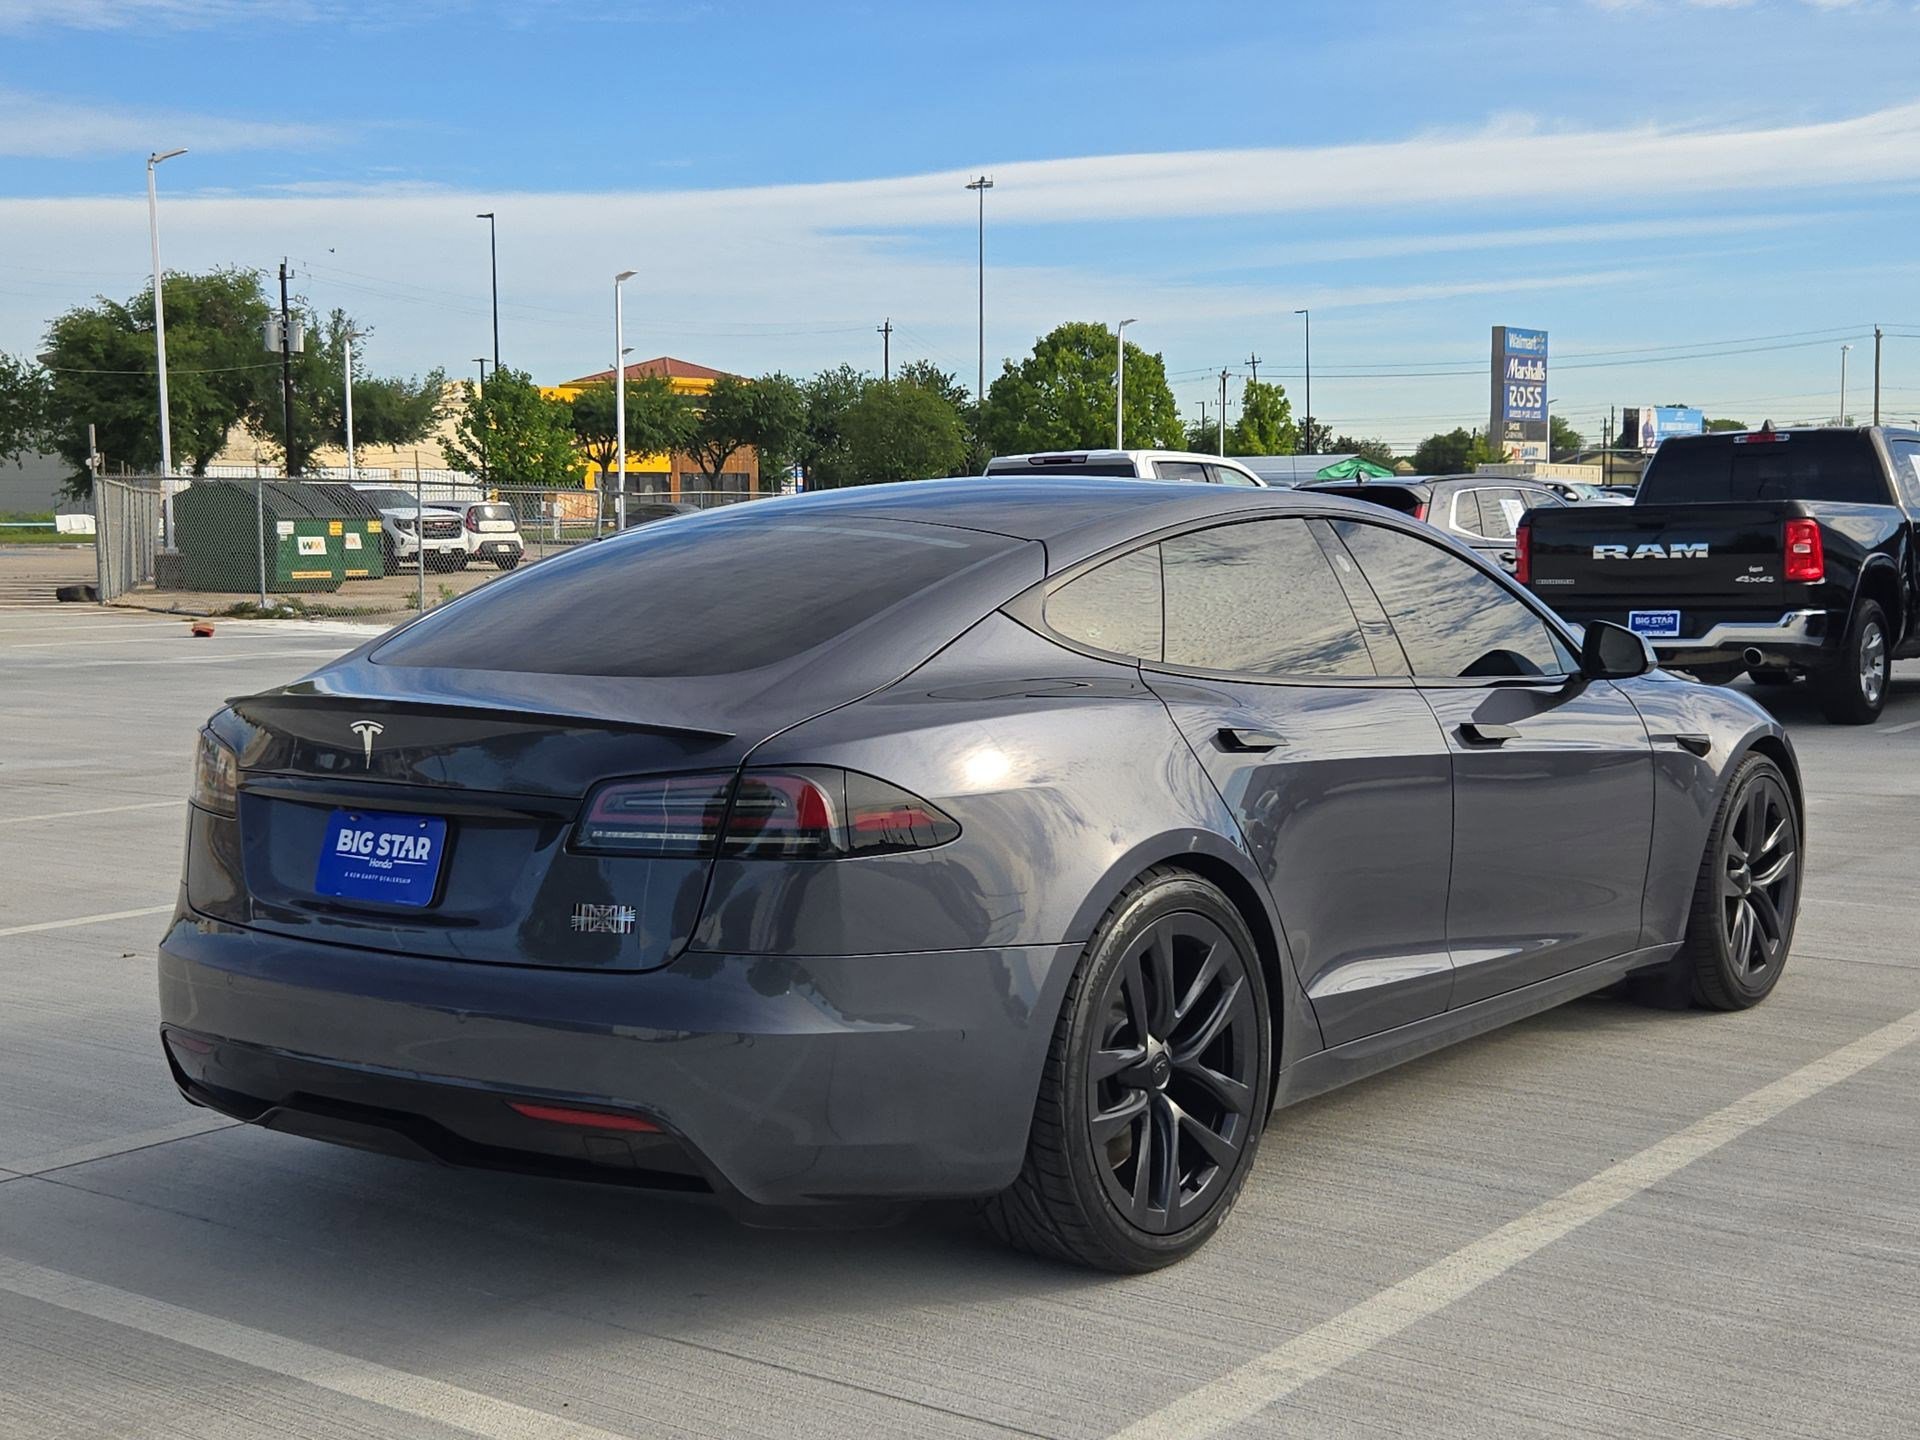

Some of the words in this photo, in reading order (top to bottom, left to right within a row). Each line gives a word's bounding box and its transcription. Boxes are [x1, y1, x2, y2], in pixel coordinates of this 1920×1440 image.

[1508, 333, 1537, 350] Walmart
[1506, 358, 1545, 381] Marshalls
[1509, 386, 1542, 408] ROSS
[1593, 543, 1709, 560] RAM
[1635, 616, 1650, 625] BIG
[1651, 616, 1674, 625] STAR
[336, 828, 375, 855] BIG
[376, 833, 431, 860] STAR
[369, 858, 393, 869] Honda
